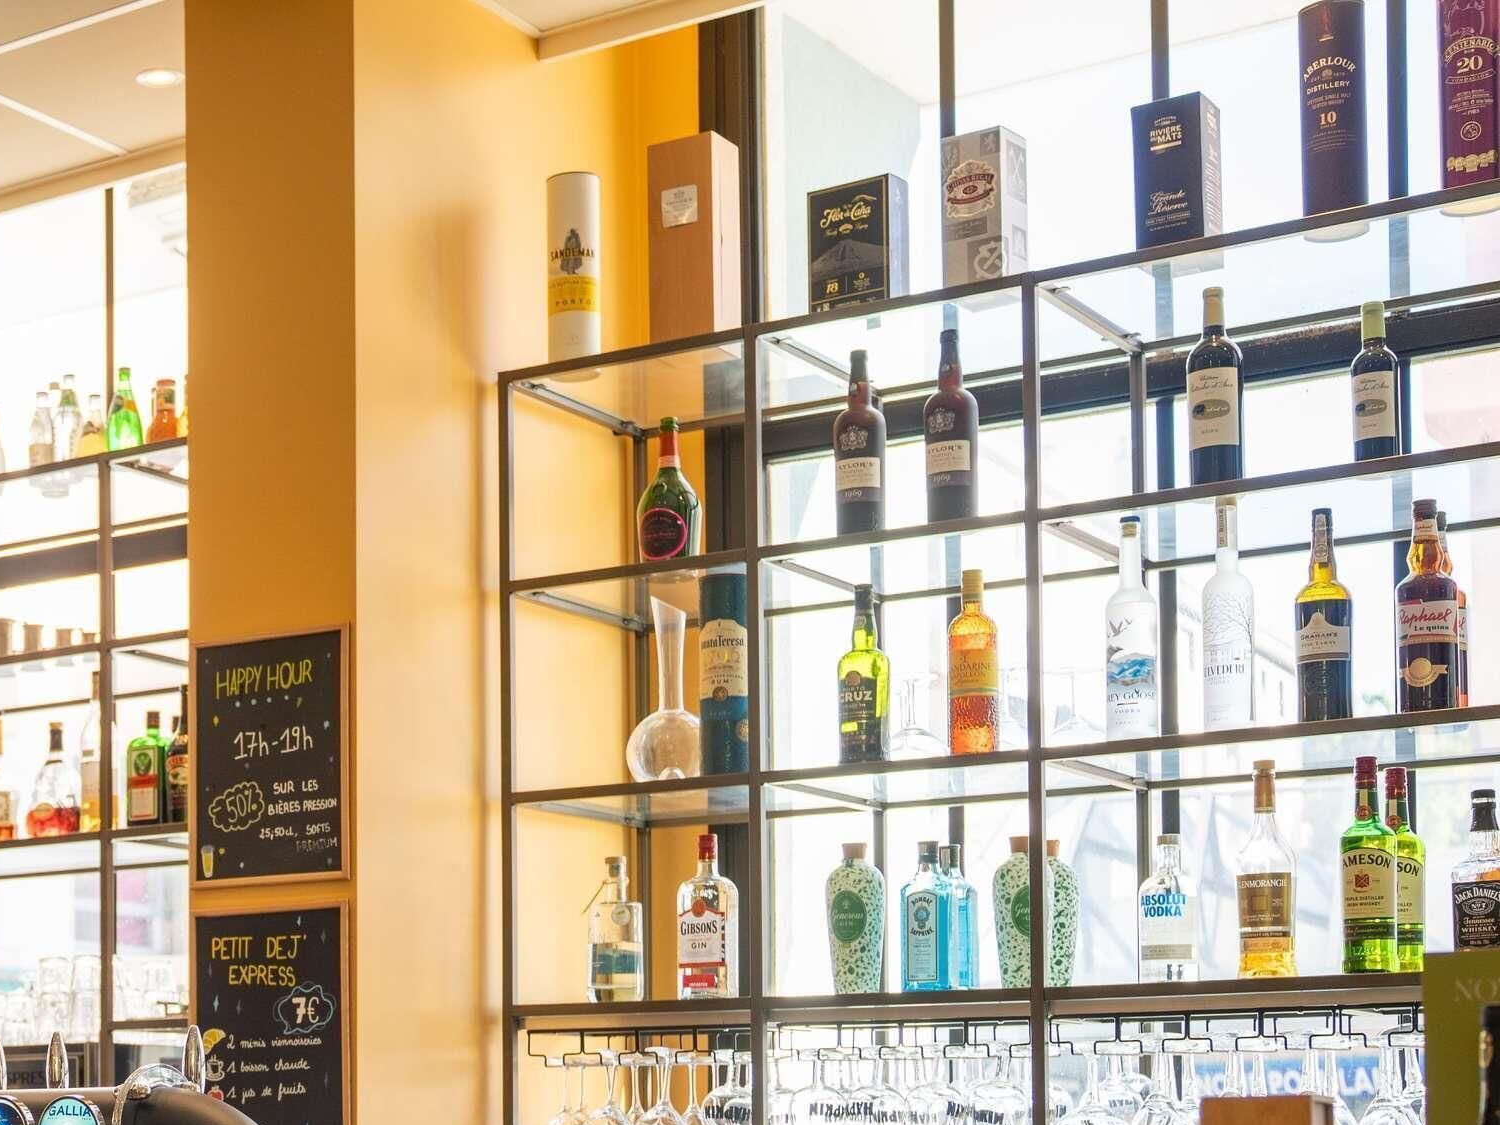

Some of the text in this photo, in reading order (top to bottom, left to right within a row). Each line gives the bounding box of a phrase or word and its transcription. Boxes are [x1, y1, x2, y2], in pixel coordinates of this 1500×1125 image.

[1303, 56, 1357, 82] ABERLOUR
[1457, 55, 1483, 74] 20
[1306, 80, 1350, 95] DISTILLERY
[1319, 111, 1337, 125] 10
[216, 659, 313, 700] HAPPY HOUR
[233, 725, 314, 760] 17h-19h
[273, 779, 320, 795] SUR LES
[267, 798, 338, 816] BIÈRES PRESSION
[1141, 893, 1186, 906] ABSOLUT
[1456, 887, 1473, 904] JACK
[1144, 906, 1182, 918] VODKA
[1461, 926, 1498, 934] WHISKEY
[211, 936, 252, 960] PETIT
[691, 942, 707, 950] GIN
[228, 964, 297, 988] EXPRESS
[291, 996, 320, 1024] 7€
[226, 1033, 323, 1050] 2 minis viennoiseries
[226, 1057, 311, 1073] 1 boisson chaude
[226, 1081, 307, 1105] 1 jus de fruits
[48, 1105, 91, 1117] GALLIA
